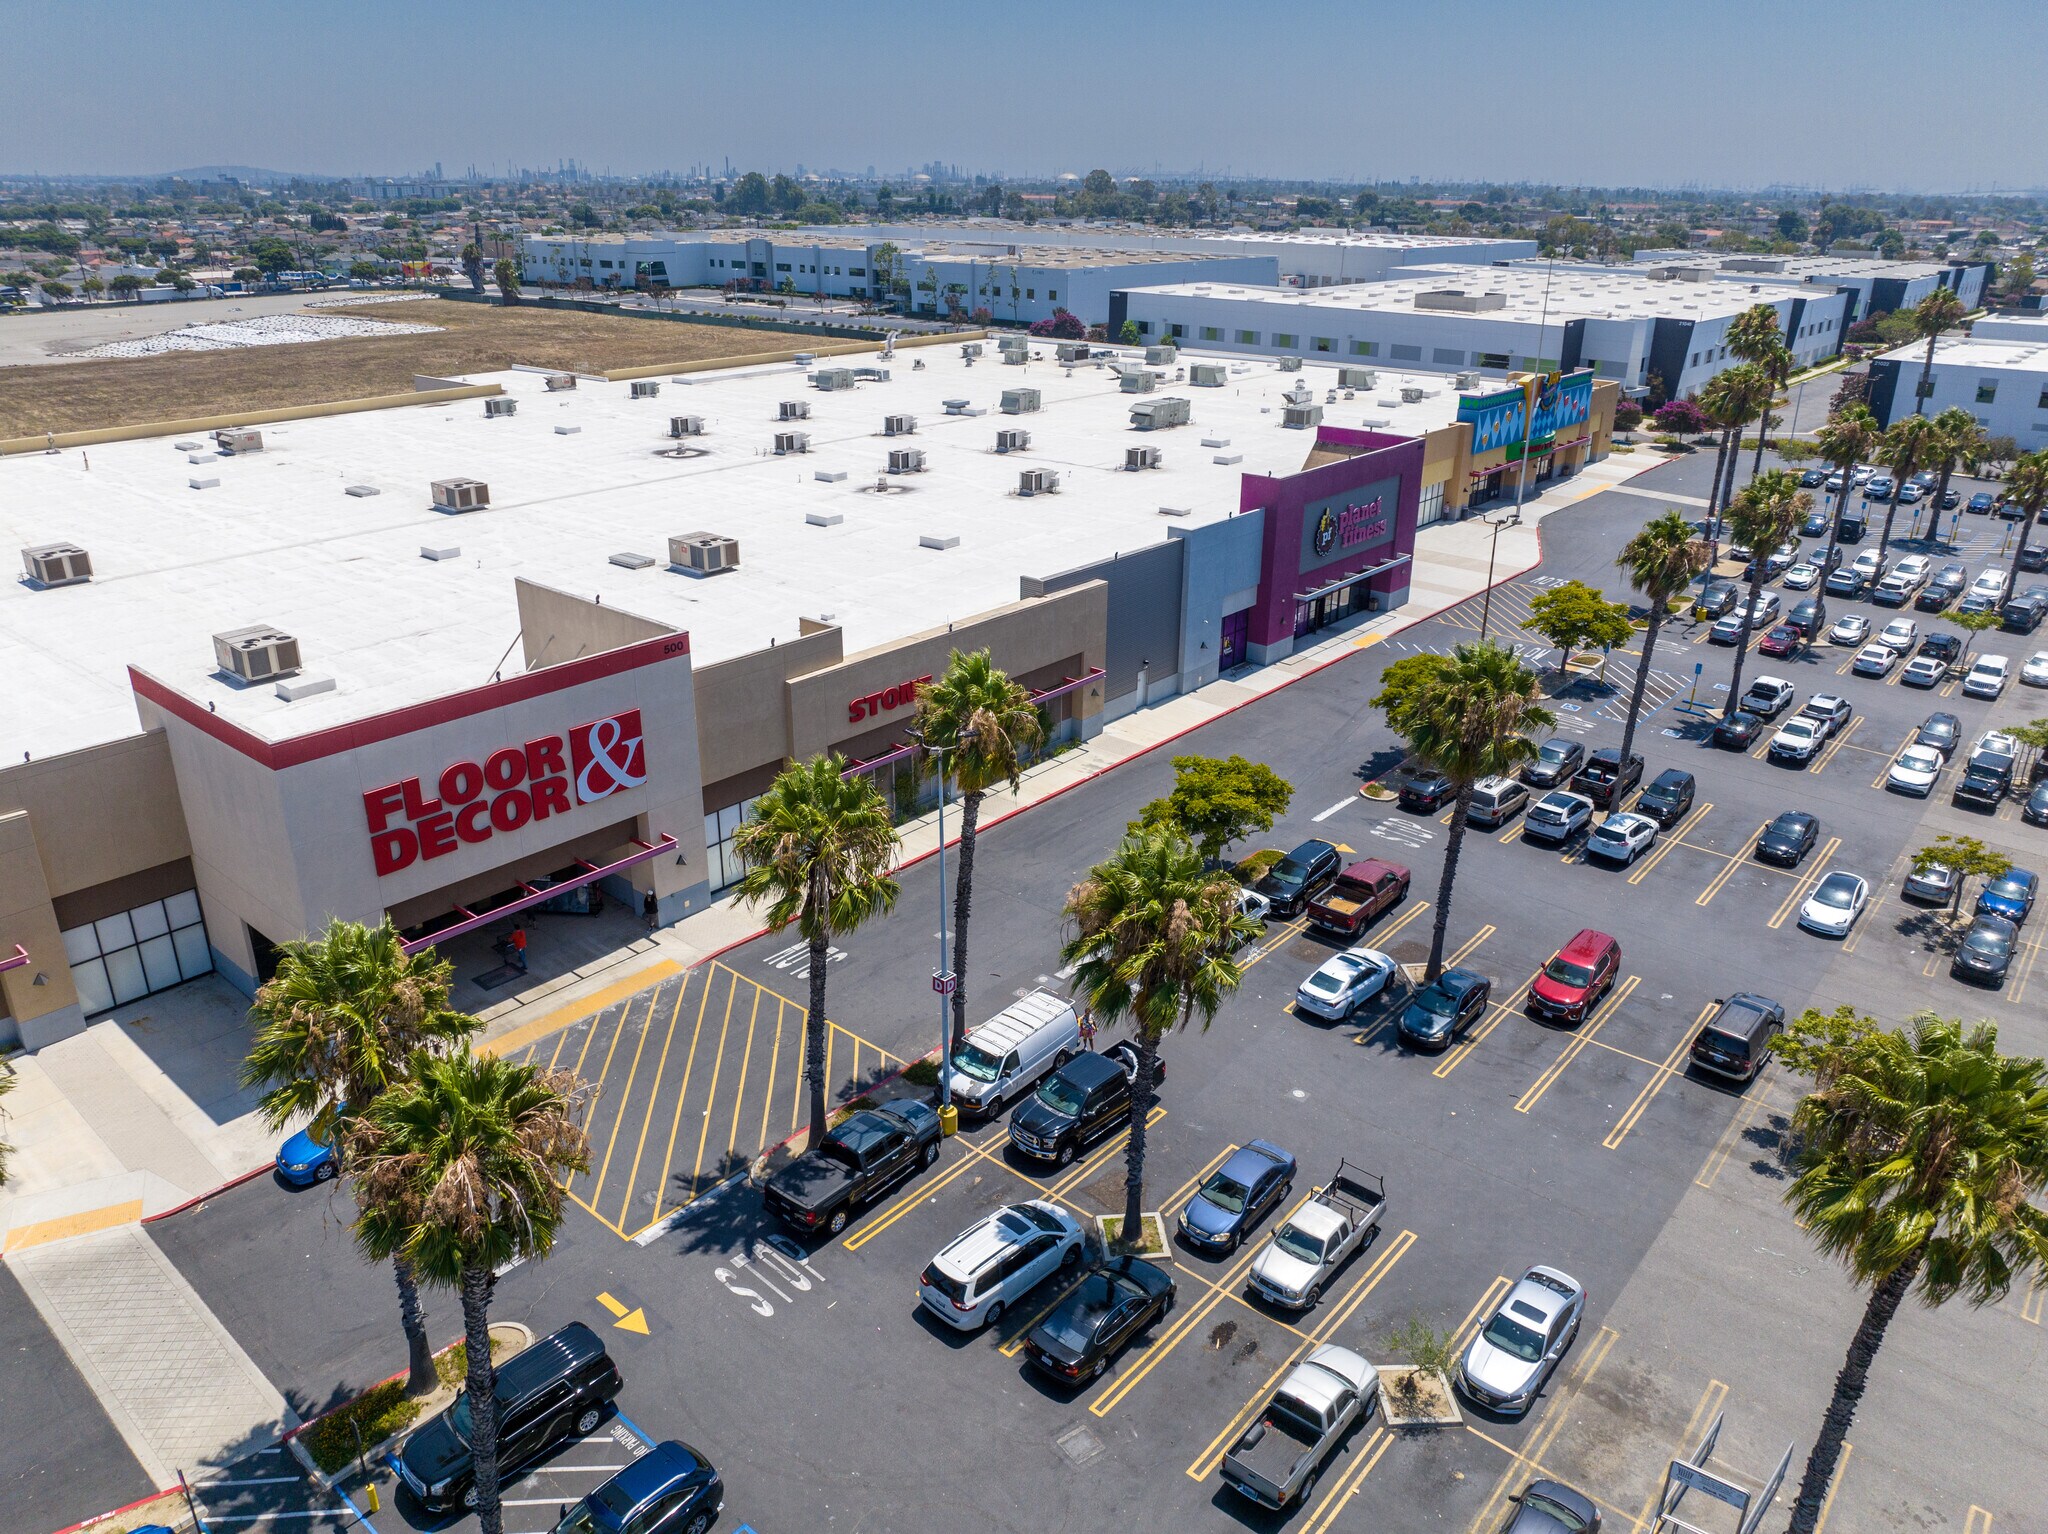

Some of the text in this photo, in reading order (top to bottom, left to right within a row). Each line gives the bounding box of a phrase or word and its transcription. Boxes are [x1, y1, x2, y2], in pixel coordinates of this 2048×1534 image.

[1339, 495, 1383, 535] planet
[1321, 526, 1333, 546] pf
[1341, 518, 1388, 548] fitness
[663, 641, 684, 655] 500
[848, 673, 933, 723] STON
[576, 718, 648, 803] &
[363, 735, 567, 834] FLOOR
[370, 776, 572, 877] DECOR
[1369, 817, 1438, 848] STOP
[934, 979, 943, 991] D
[946, 979, 955, 992] D
[714, 1234, 826, 1317] STOP
[610, 1424, 641, 1451] PARKING
